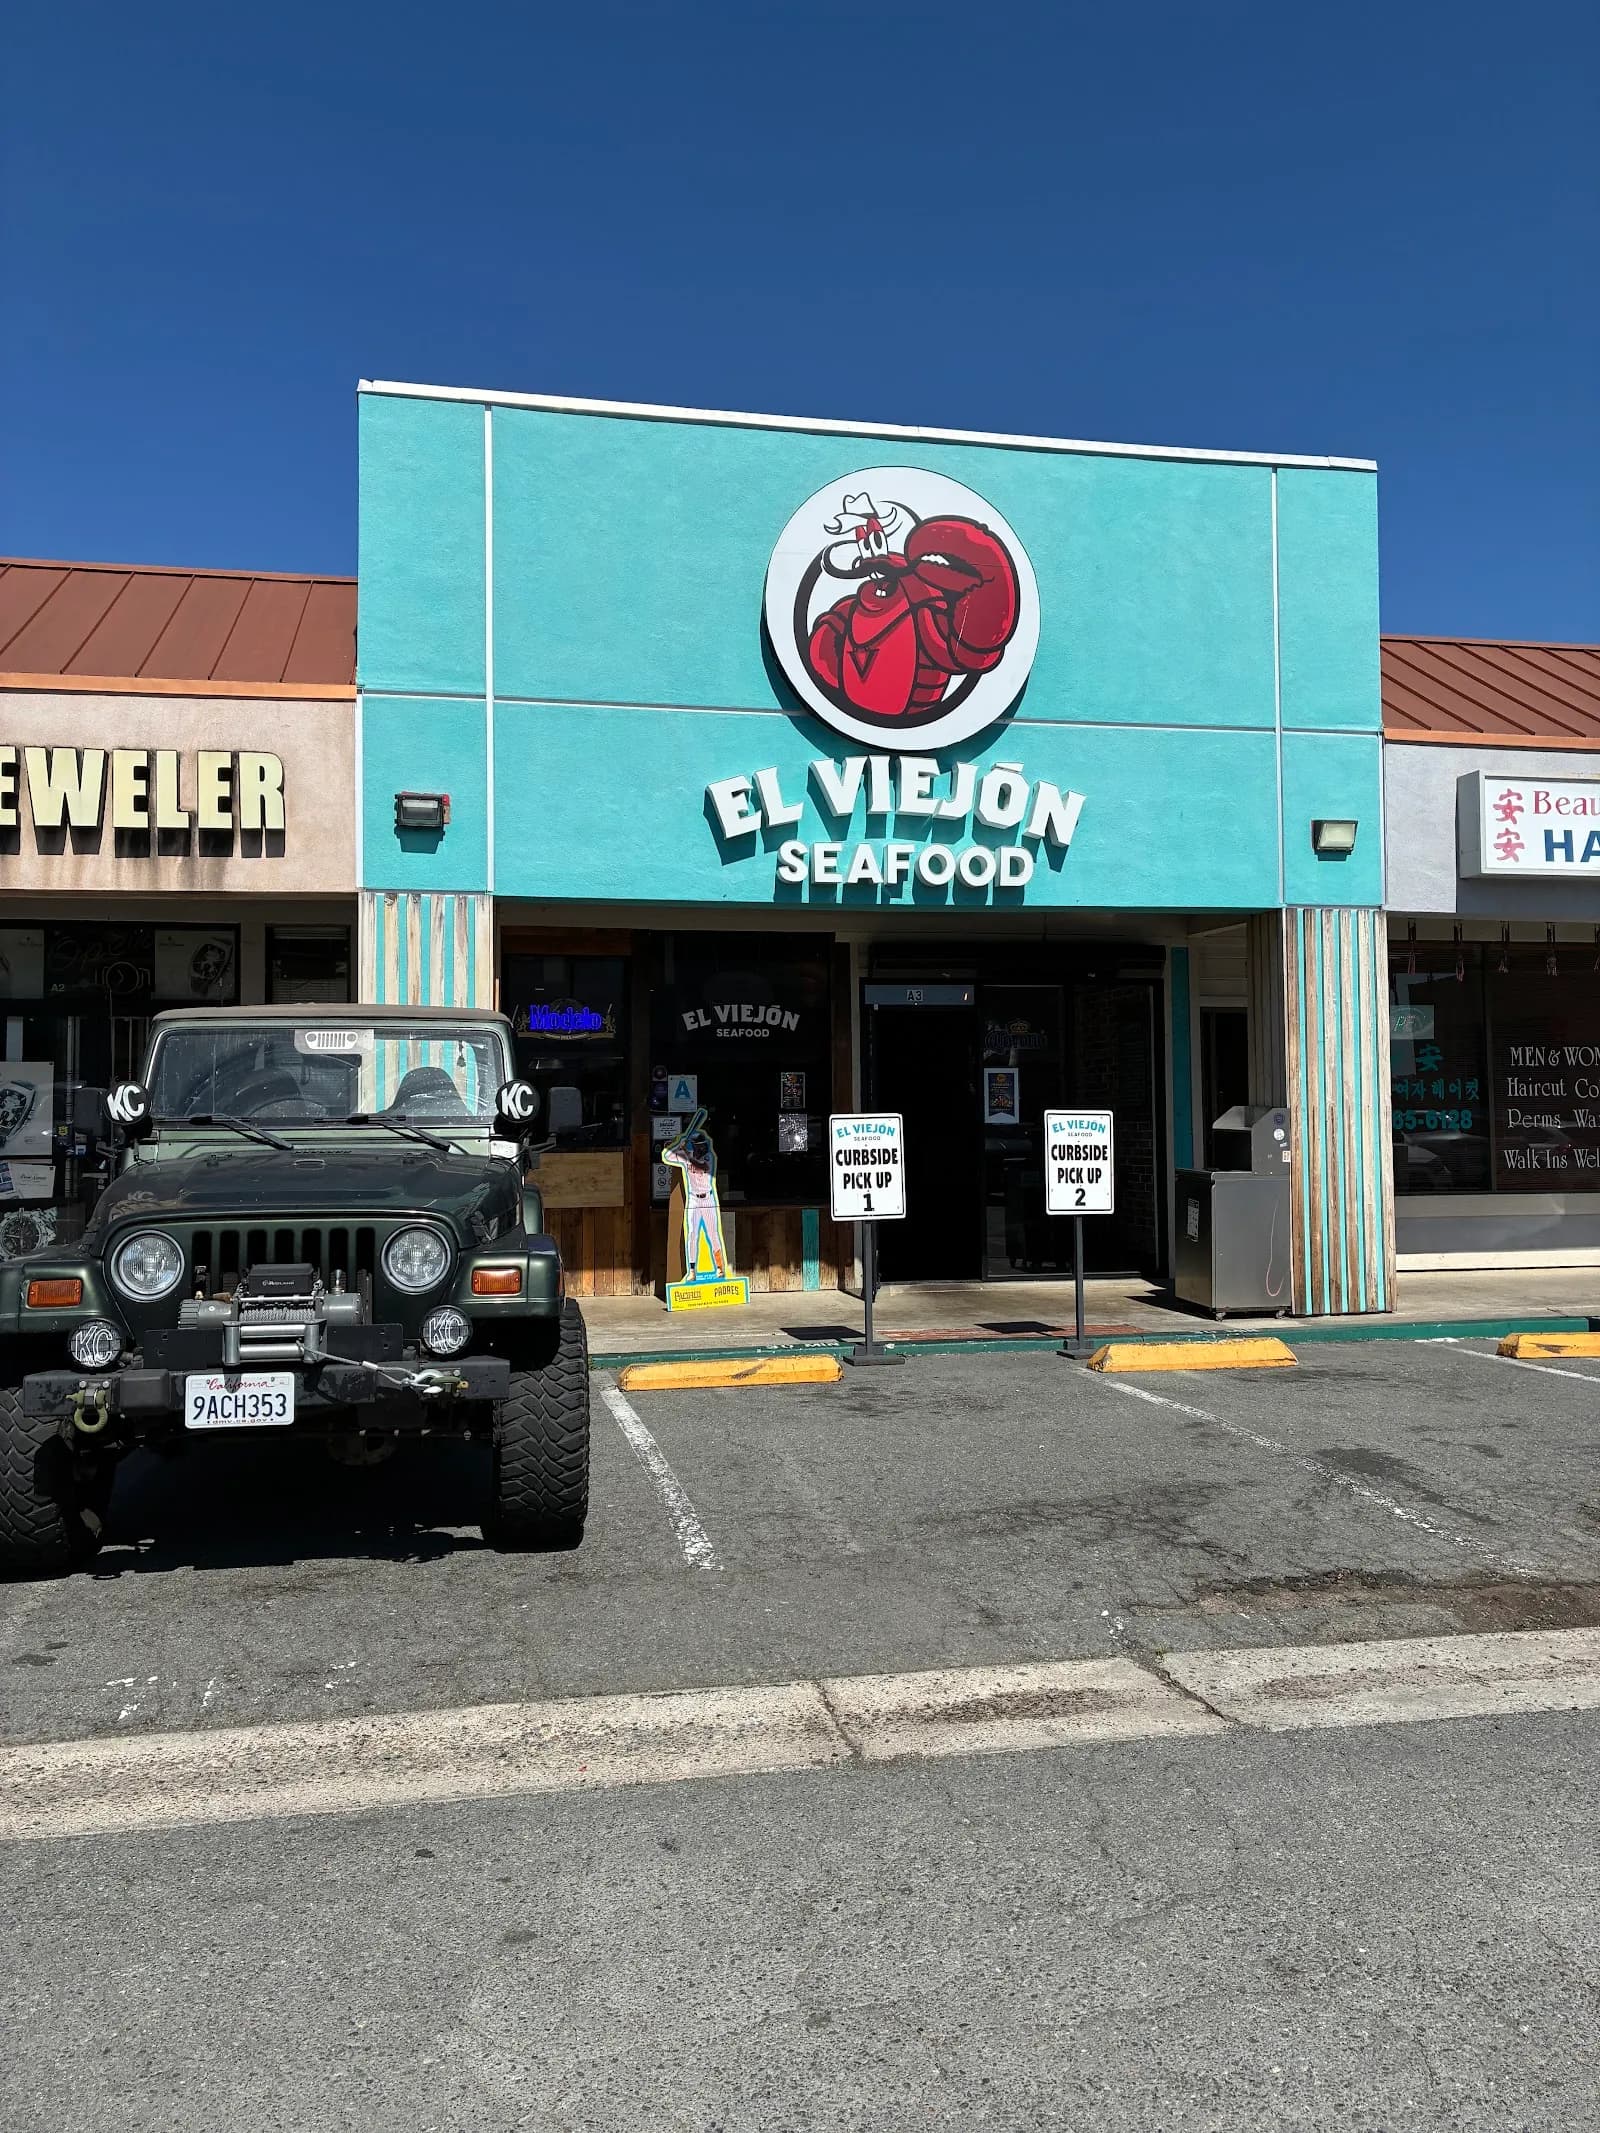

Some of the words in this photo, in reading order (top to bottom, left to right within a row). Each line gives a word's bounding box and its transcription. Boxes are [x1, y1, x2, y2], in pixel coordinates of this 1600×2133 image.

[705, 766, 803, 840] EL
[1544, 829, 1600, 863] HA
[777, 840, 1035, 888] SEAFOOD
[907, 990, 922, 1001] A3
[529, 1004, 602, 1031] Modelo
[681, 1008, 712, 1031] EL
[716, 1028, 770, 1038] SEAFOOD
[1509, 1046, 1546, 1067] MEN
[1548, 1049, 1561, 1067] &
[674, 1080, 691, 1099] A
[1506, 1077, 1568, 1097] Haircut
[1575, 1078, 1600, 1098] Co
[107, 1084, 145, 1122] KC
[501, 1083, 534, 1120] KC
[1051, 1122, 1066, 1134] EL
[1507, 1108, 1562, 1129] Perms
[1572, 1108, 1600, 1129] Wa
[836, 1127, 851, 1138] EL
[835, 1148, 898, 1167] CURBSIDE
[1051, 1144, 1108, 1161] CURBSIDE
[1504, 1148, 1541, 1169] Walk
[1545, 1148, 1568, 1169] Ins
[843, 1171, 872, 1190] PICK
[876, 1171, 892, 1189] UP
[1057, 1167, 1084, 1184] PICK
[1087, 1167, 1102, 1184] UP
[863, 1193, 875, 1212] 1
[1075, 1187, 1087, 1207] 2
[429, 1312, 464, 1352] KC
[75, 1325, 113, 1367] KC
[208, 1377, 275, 1392] California
[192, 1393, 288, 1421] 9ACH353
